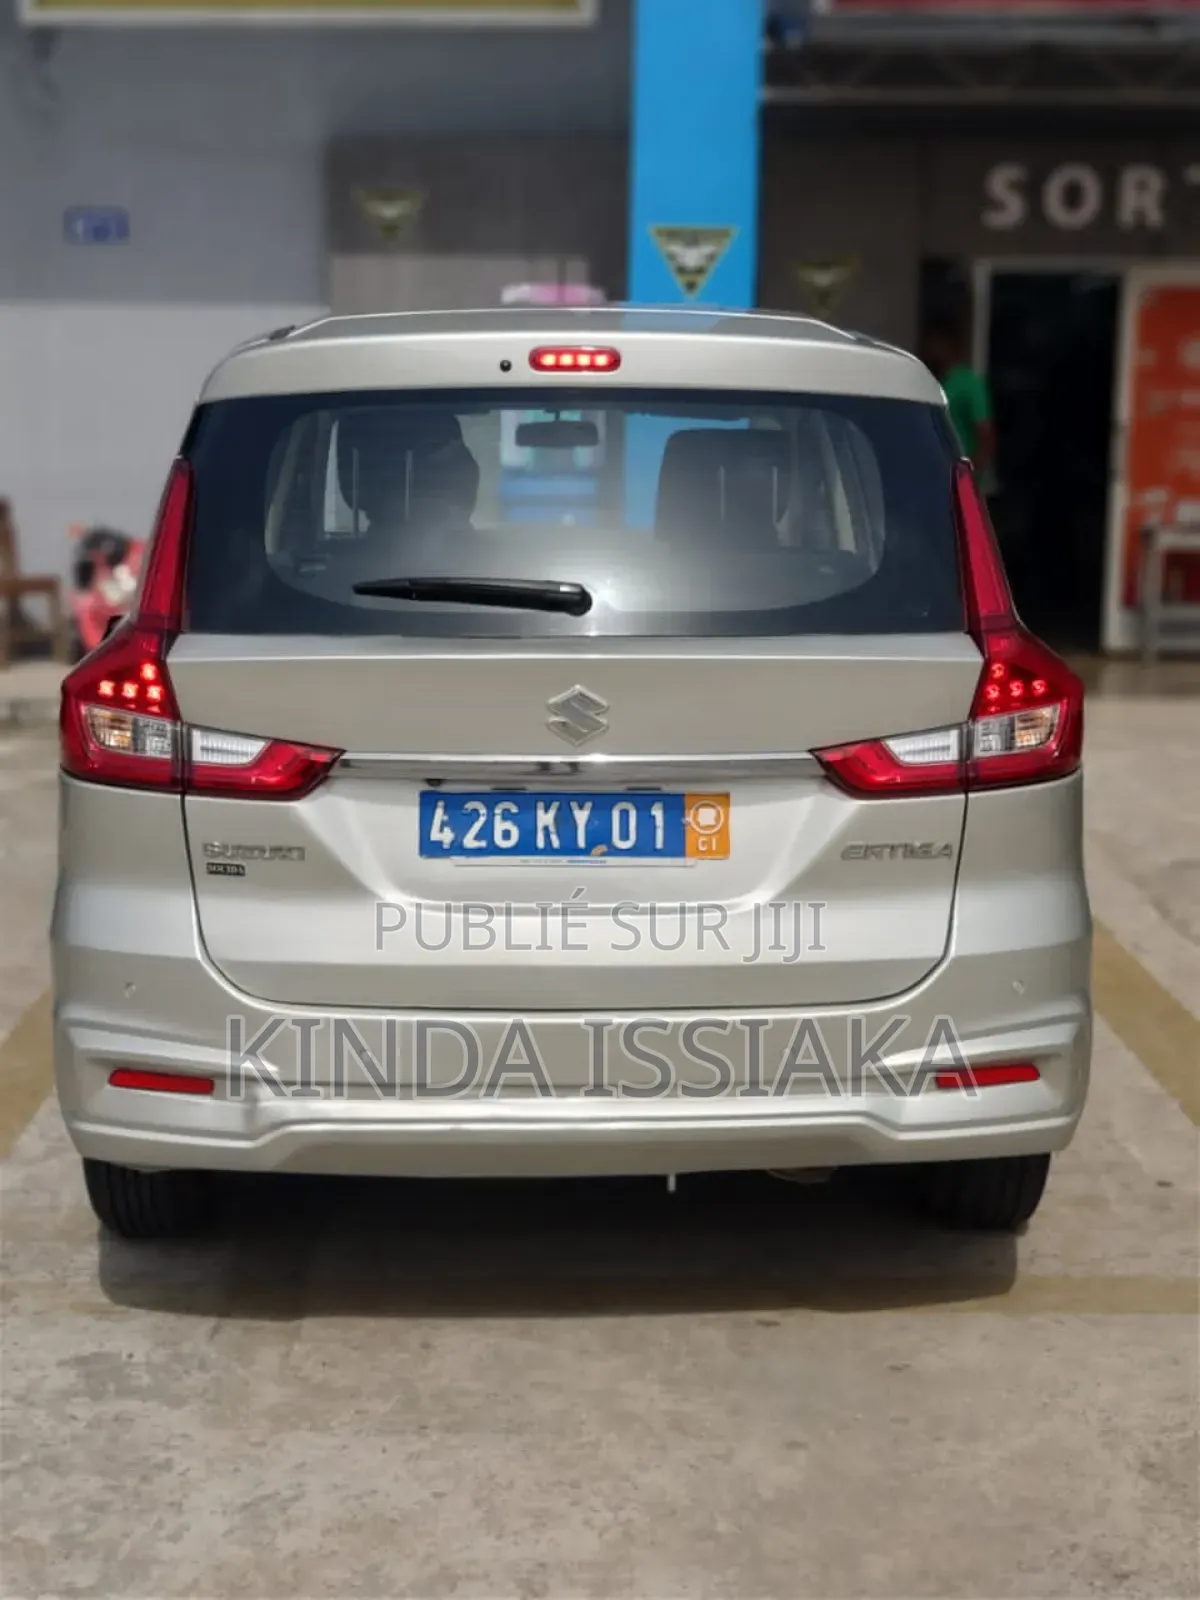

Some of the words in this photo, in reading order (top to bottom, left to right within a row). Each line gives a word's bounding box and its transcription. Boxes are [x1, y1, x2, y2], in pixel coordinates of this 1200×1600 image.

[429, 801, 520, 849] 426
[536, 801, 592, 850] KY
[612, 801, 665, 850] 01
[841, 842, 953, 861] ERTIGA
